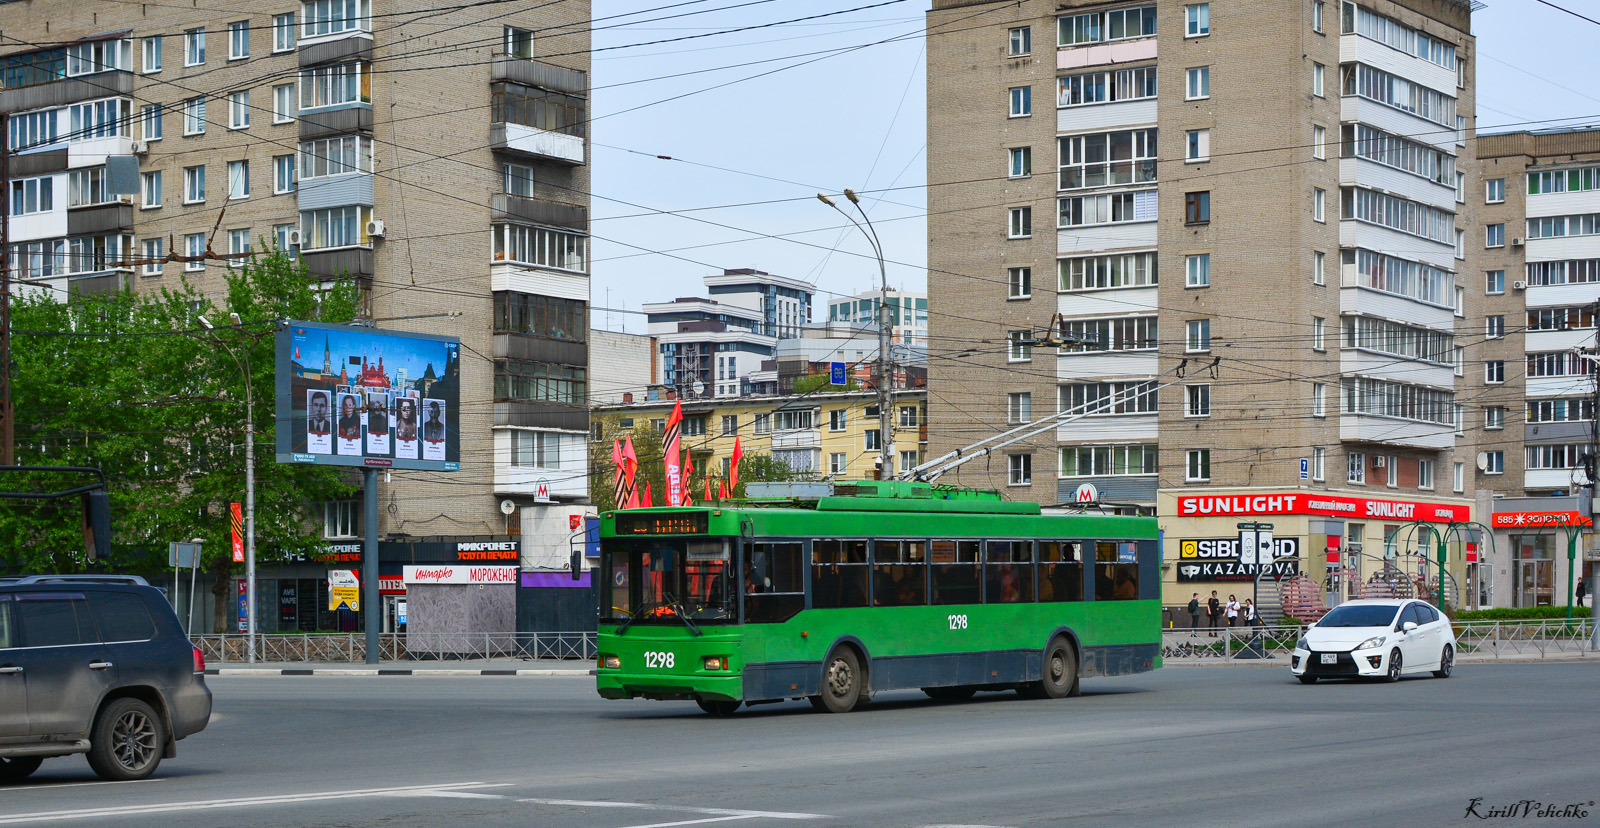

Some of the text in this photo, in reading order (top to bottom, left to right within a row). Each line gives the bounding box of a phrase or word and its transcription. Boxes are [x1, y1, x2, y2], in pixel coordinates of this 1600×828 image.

[1302, 461, 1307, 470] 7
[1183, 496, 1296, 514] SUNLIGHT
[1366, 501, 1415, 518] SUNLIGHT
[1497, 515, 1514, 524] 585
[457, 542, 518, 551] МИКРОНЕТ
[457, 551, 518, 560] УСЛУГИ ПЕЧАТИ
[415, 567, 453, 582] Инмарко
[1203, 563, 1295, 576] KAZANOVA
[948, 614, 968, 630] 1298
[644, 651, 675, 668] 1298
